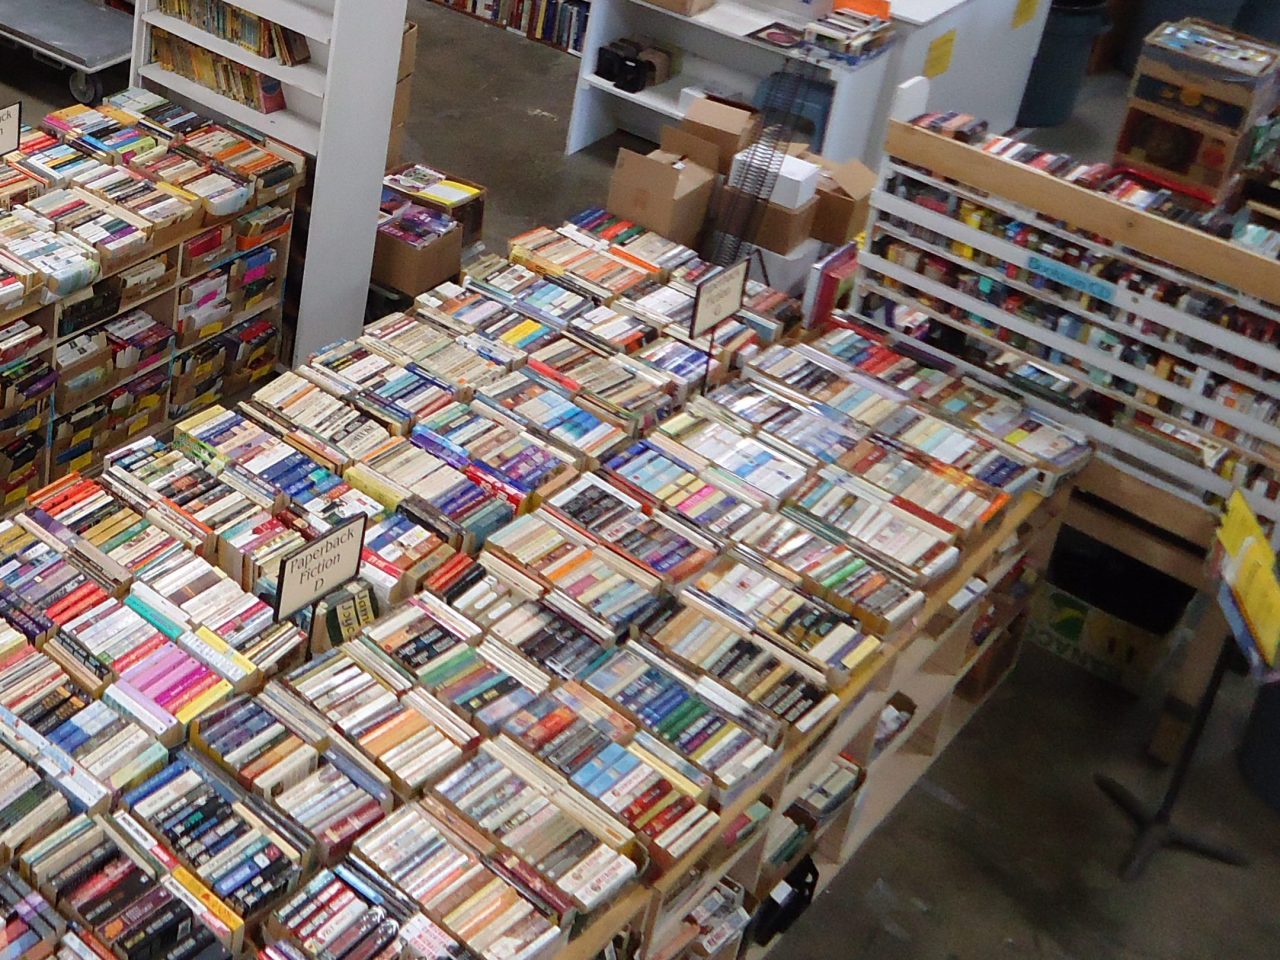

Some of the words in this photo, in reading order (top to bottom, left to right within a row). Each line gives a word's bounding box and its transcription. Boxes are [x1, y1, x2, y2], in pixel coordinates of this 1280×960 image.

[290, 527, 355, 574] Paperback
[300, 553, 341, 585] Fiction
[314, 577, 324, 592] D
[341, 604, 356, 635] Joyc
[357, 589, 371, 625] Jam
